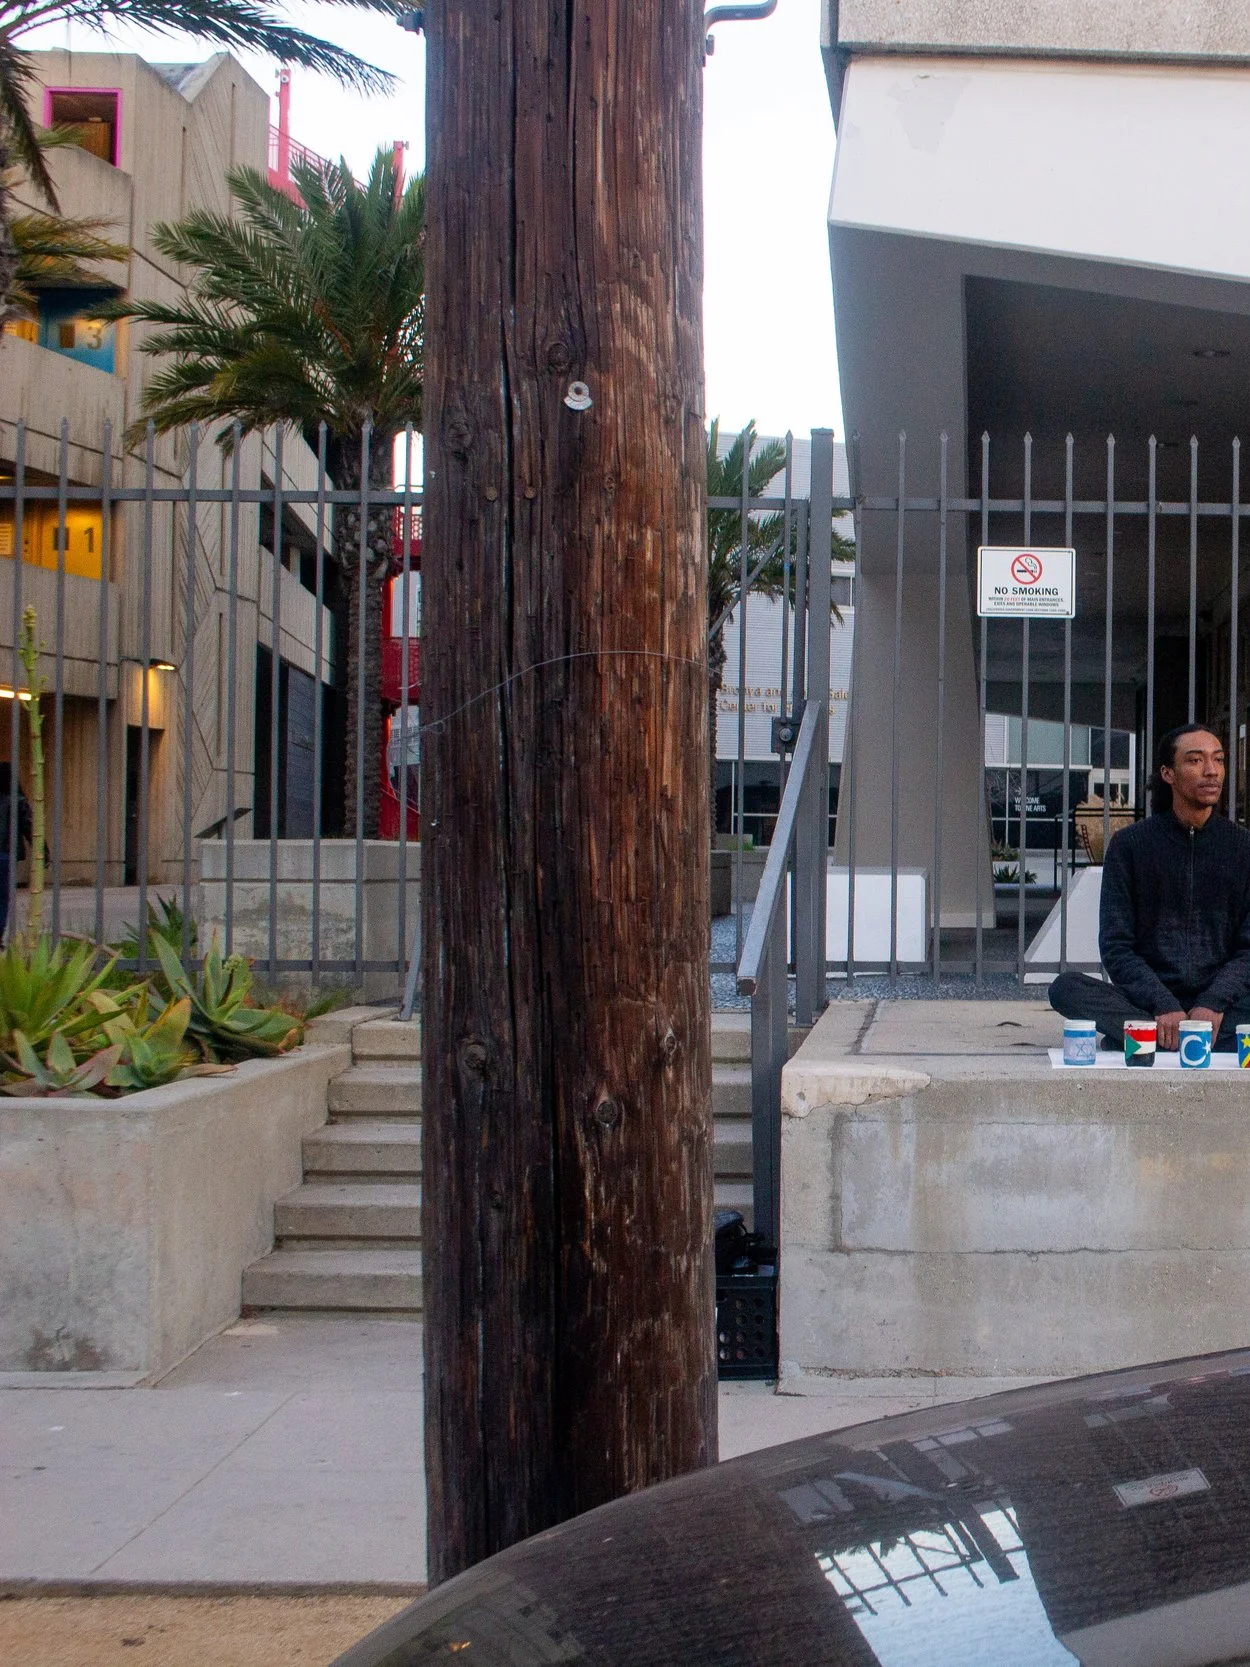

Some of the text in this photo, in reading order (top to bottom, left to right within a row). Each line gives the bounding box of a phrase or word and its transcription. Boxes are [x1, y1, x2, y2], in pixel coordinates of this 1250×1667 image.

[87, 325, 102, 350] 3
[84, 527, 94, 553] 1
[994, 586, 1059, 596] NO SMOKING
[1033, 804, 1047, 812] ARTS
